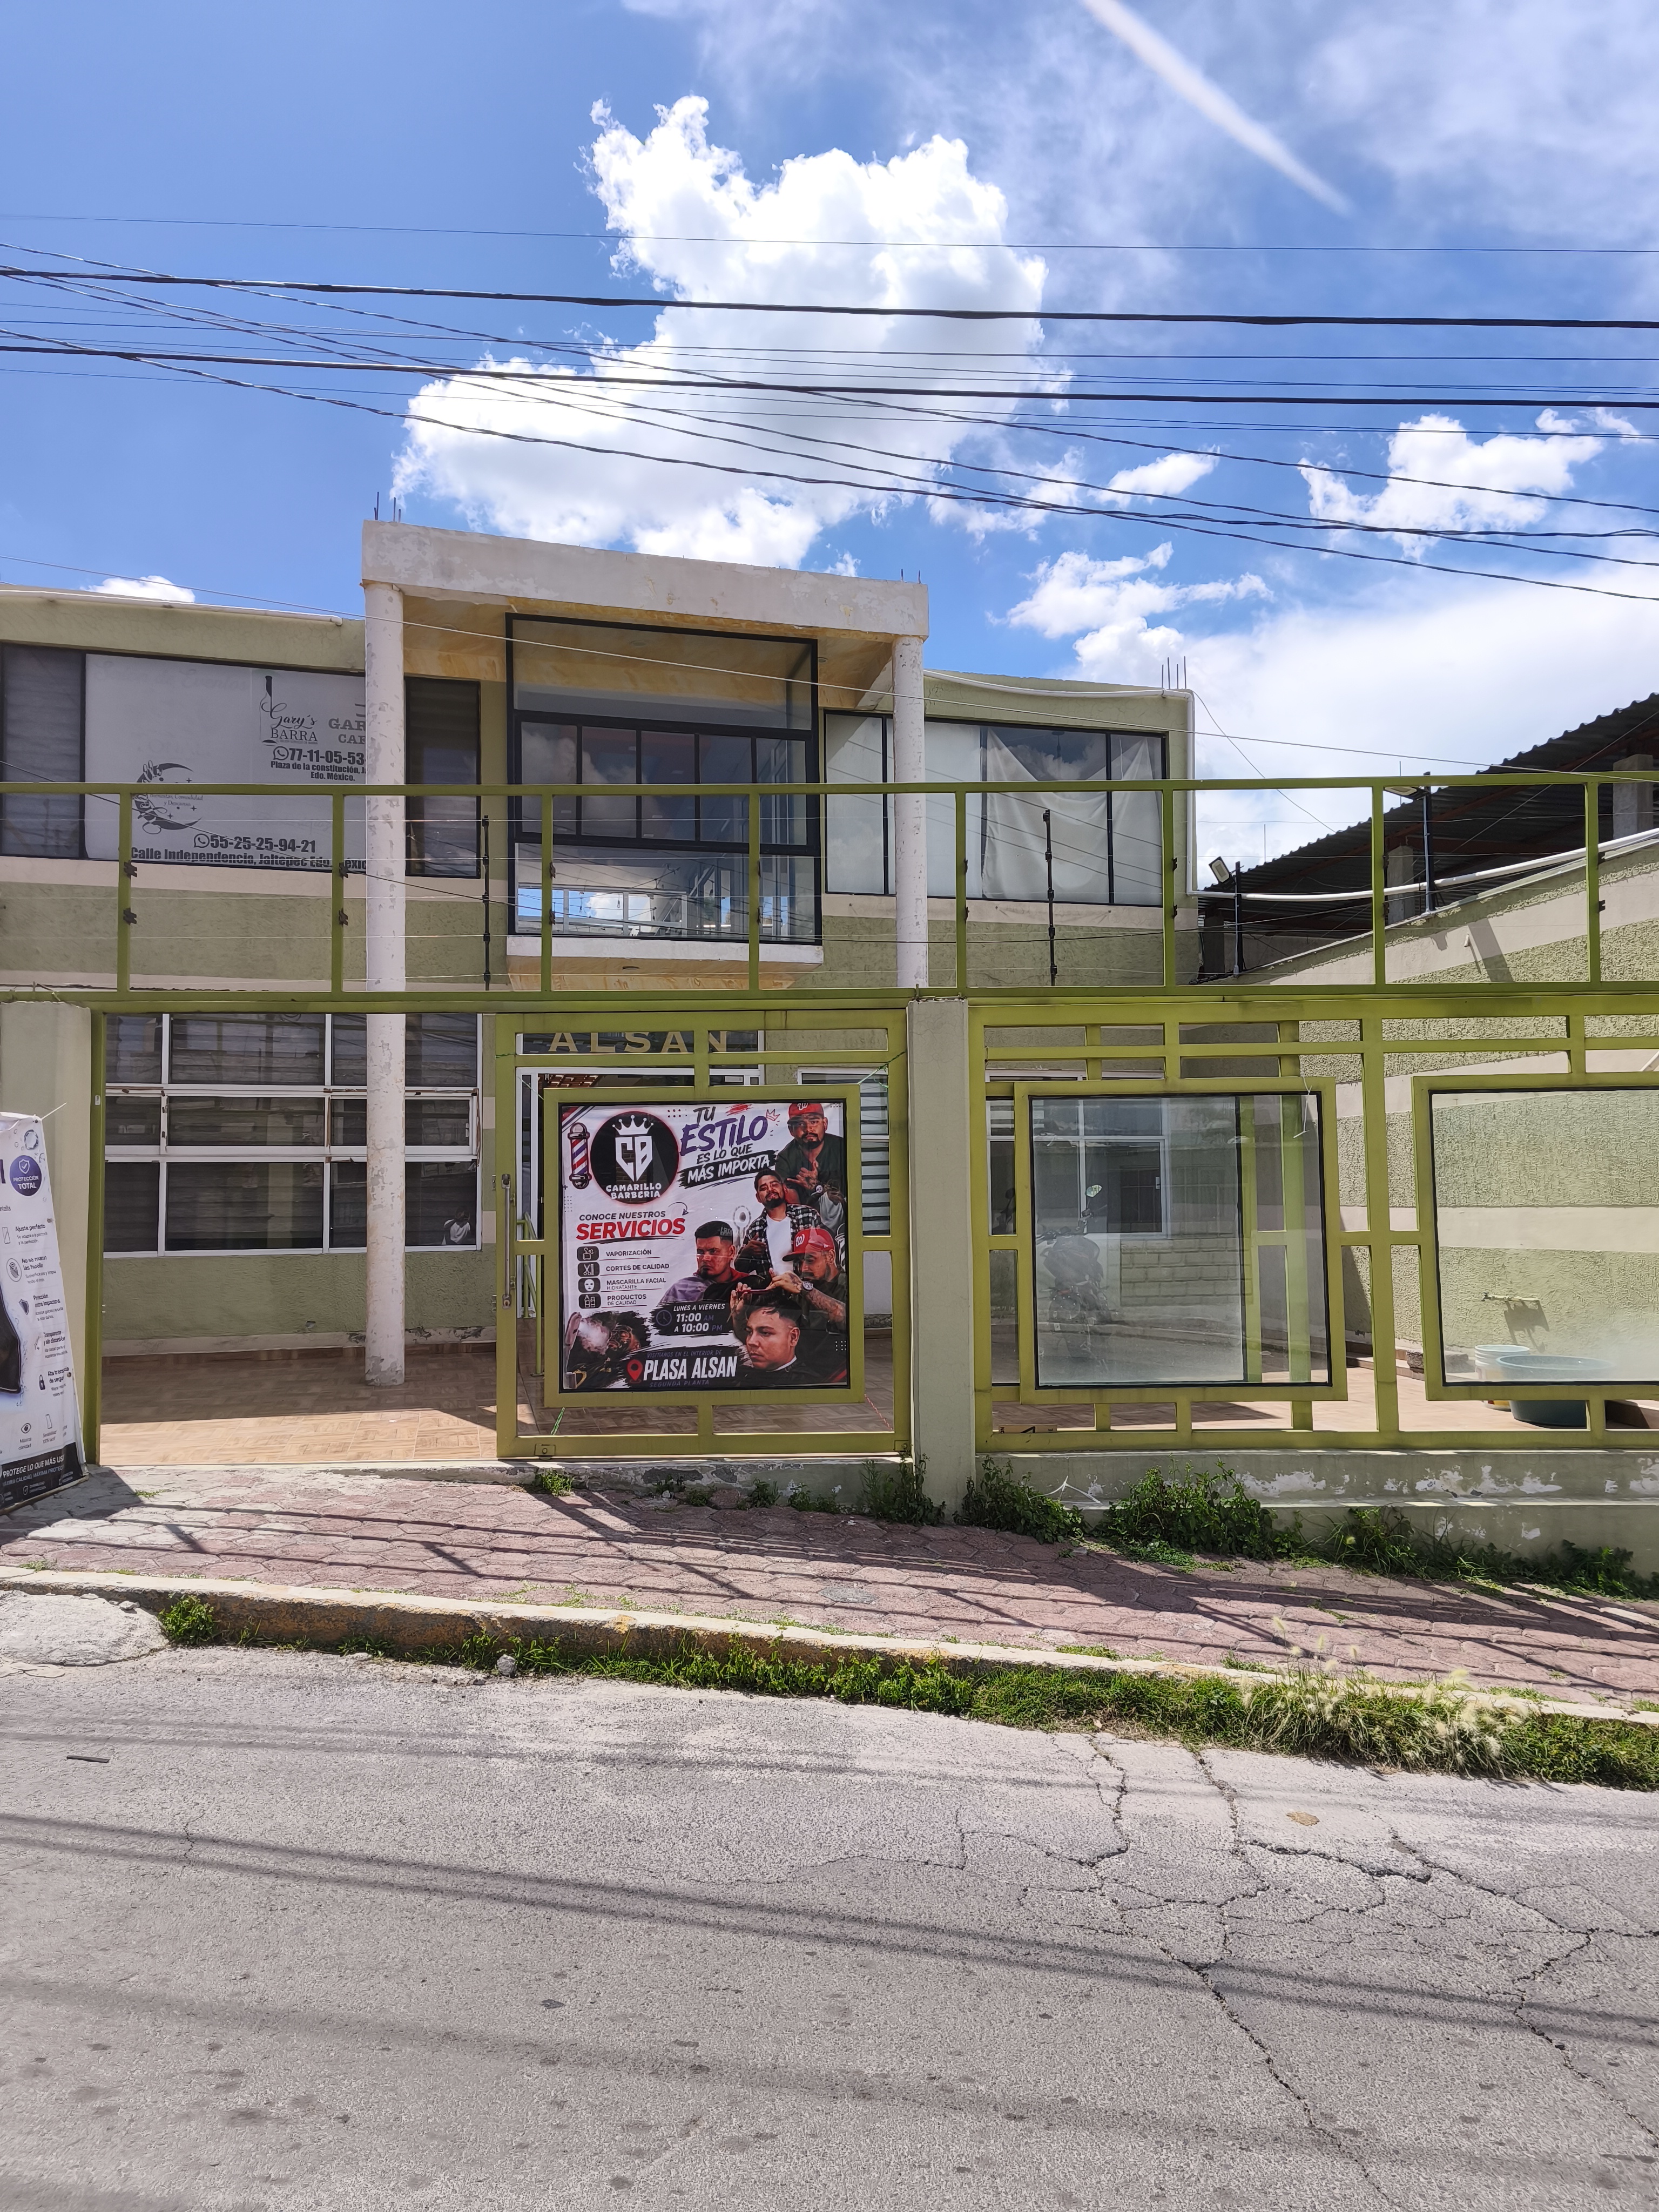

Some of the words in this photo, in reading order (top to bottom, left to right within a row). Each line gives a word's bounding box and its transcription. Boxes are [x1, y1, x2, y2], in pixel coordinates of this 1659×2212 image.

[271, 729, 319, 741] BARRA
[289, 747, 366, 766] 77-11-05-53
[271, 761, 291, 769] Plaza
[312, 764, 360, 774] constitución,
[327, 772, 355, 781] México.
[210, 835, 315, 853] 55-25-25-94-21
[131, 847, 161, 860] Calle
[164, 849, 257, 865] Independencia,
[258, 853, 308, 867] Jaltepec
[548, 1031, 727, 1053] ALSAN
[693, 1106, 716, 1124] TU
[679, 1115, 768, 1156] ESTILO
[697, 1152, 711, 1164] ES
[713, 1149, 727, 1161] LO
[730, 1143, 753, 1158] QUE
[687, 1164, 714, 1184] MÁS
[718, 1154, 771, 1178] IMPORTA
[605, 1183, 662, 1192] CAMARILLO
[610, 1190, 660, 1199] BARBERIA
[579, 1213, 617, 1221] CONOCE
[619, 1211, 666, 1219] NUESTROS
[576, 1218, 686, 1240] SERVICIOS
[606, 1249, 652, 1257] VAPORIZACIÓN
[676, 1313, 702, 1322] 11:00
[682, 1323, 709, 1332] 10:00
[643, 1358, 687, 1381] PLASA
[691, 1356, 738, 1379] ALSAN
[3, 1466, 26, 1478] PROTEGE
[34, 1461, 44, 1469] QUE
[45, 1456, 56, 1466] MÁS
